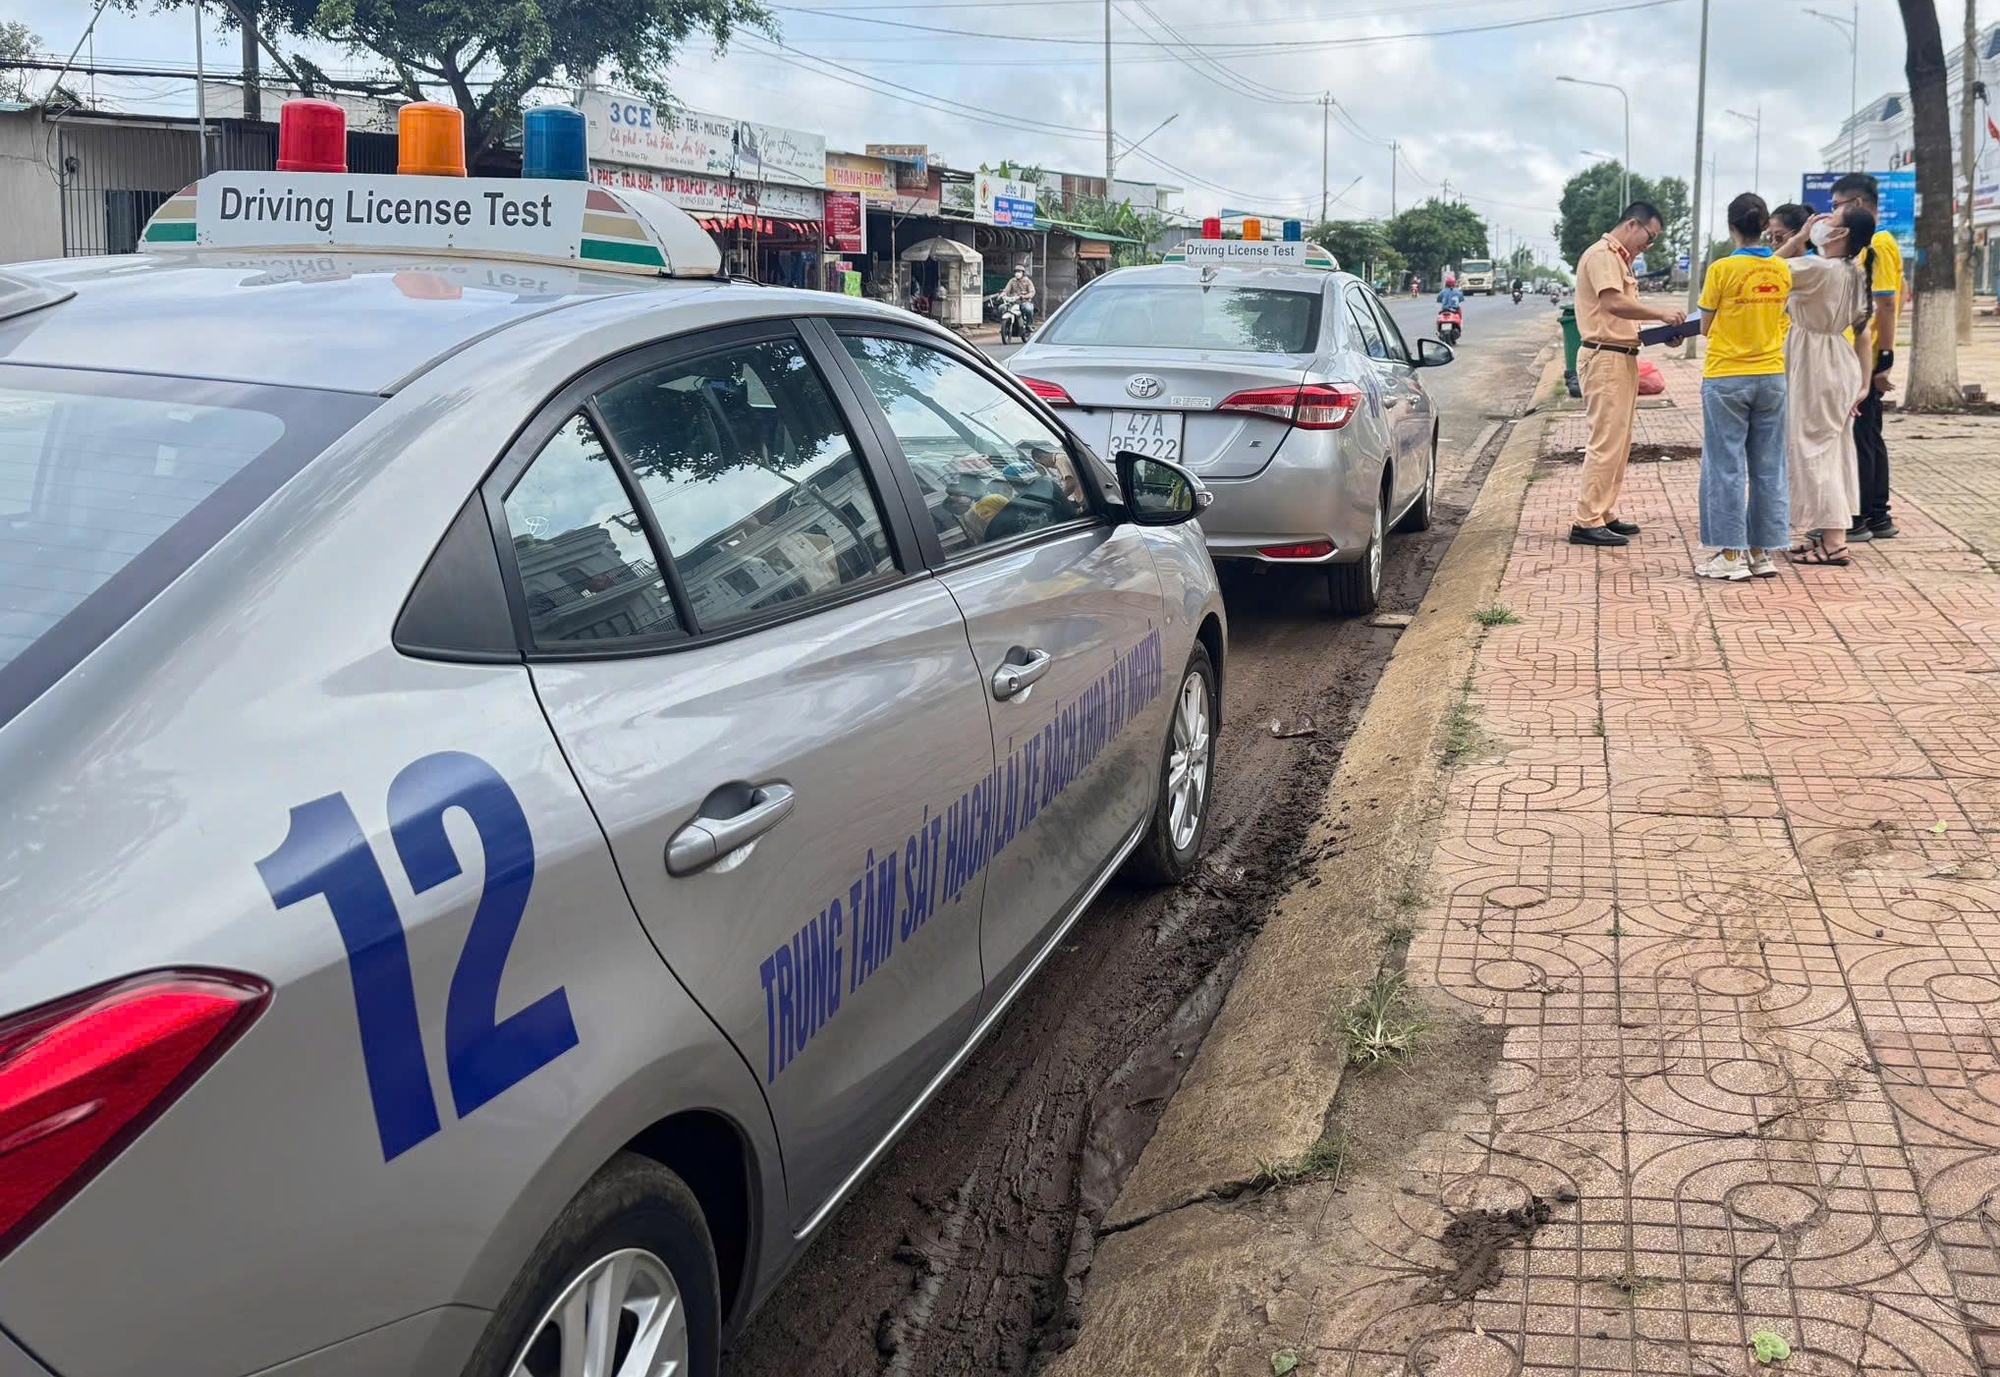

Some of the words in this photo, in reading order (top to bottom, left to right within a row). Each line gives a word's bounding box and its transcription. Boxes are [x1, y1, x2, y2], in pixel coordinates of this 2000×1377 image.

[610, 102, 651, 128] 3CE
[686, 118, 698, 133] TEA
[704, 120, 730, 138] MILKTEA
[221, 187, 334, 231] Driving
[346, 191, 471, 227] License
[484, 192, 552, 227] Test
[1187, 244, 1225, 258] Driving
[1228, 245, 1269, 256] License
[1273, 245, 1295, 256] Test
[1127, 413, 1164, 437] 47A
[759, 898, 842, 1085] TRUNG
[849, 847, 897, 996] TÂM
[900, 804, 942, 943] SÁT
[943, 773, 993, 903] HẠCH
[993, 736, 1019, 858] LÁI
[1019, 733, 1040, 832] XE
[1041, 700, 1076, 810] BÁCH
[1108, 650, 1126, 743] TÂY
[255, 751, 580, 1163] 12
